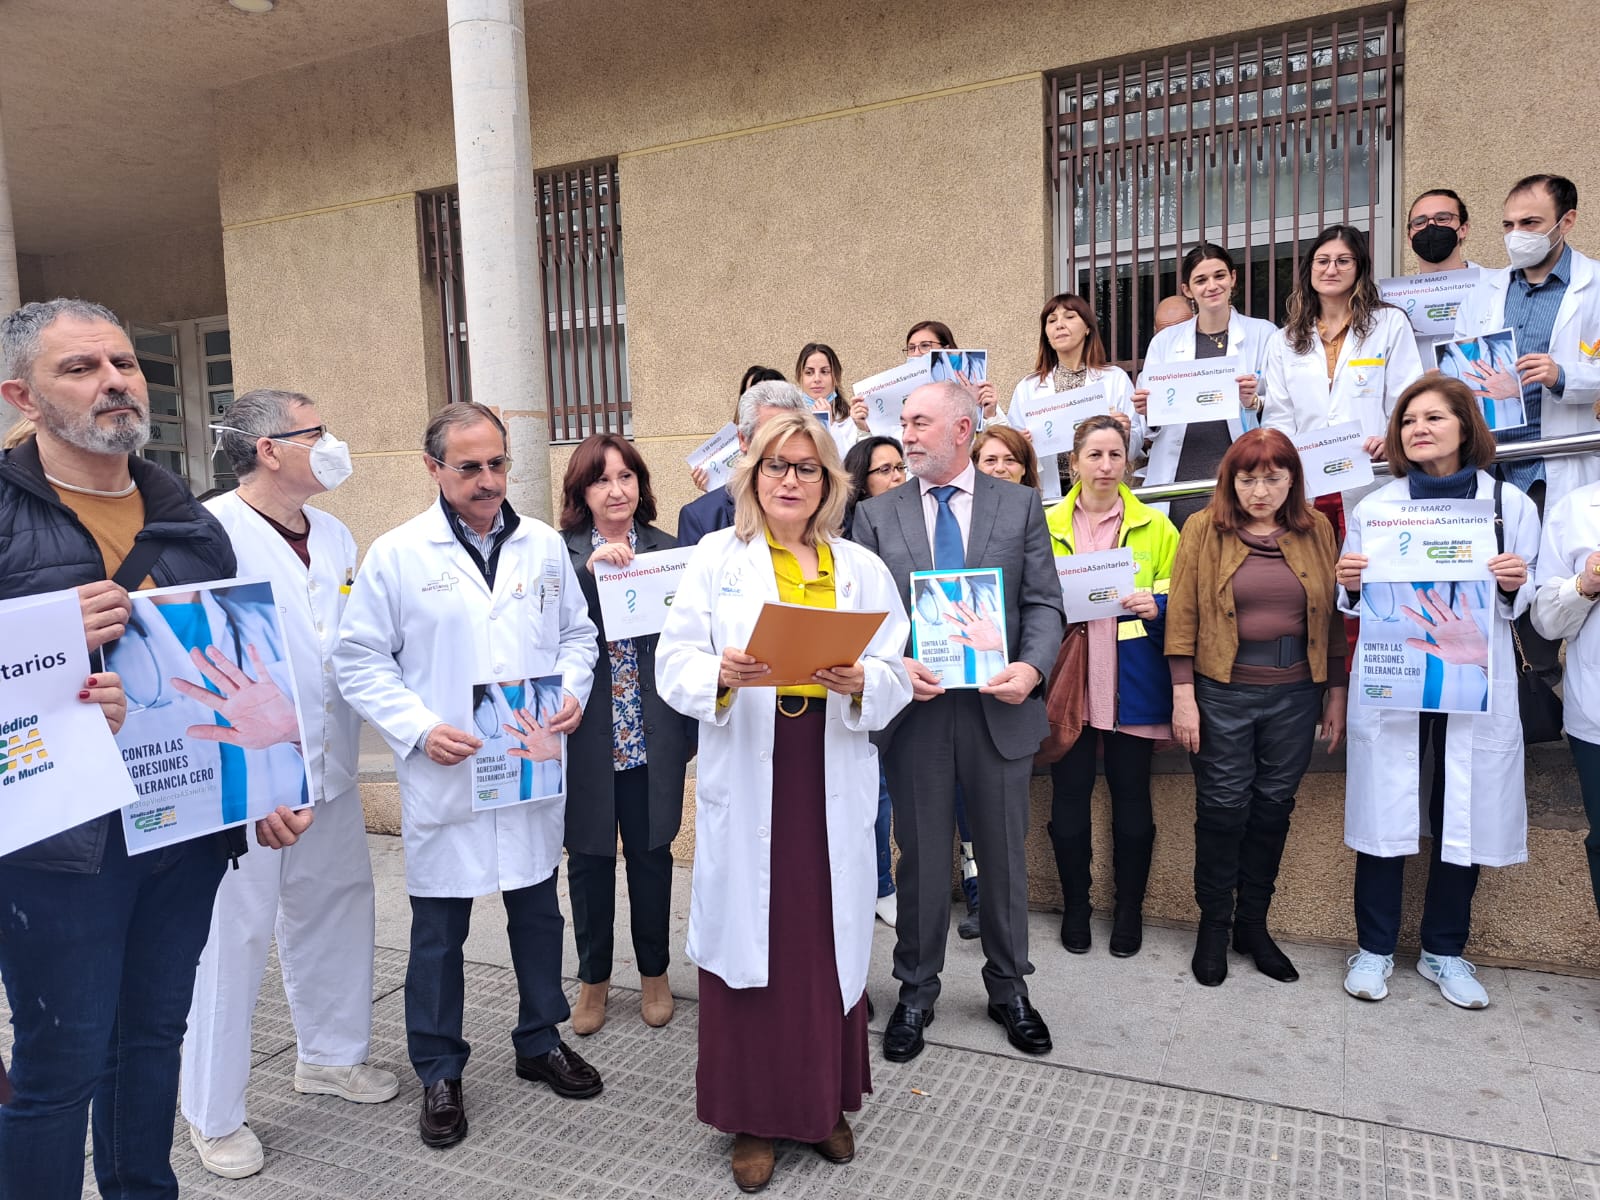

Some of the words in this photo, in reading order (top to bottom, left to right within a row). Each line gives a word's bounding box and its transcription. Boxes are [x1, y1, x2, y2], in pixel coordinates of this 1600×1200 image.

[1407, 505, 1419, 513] DE
[1420, 504, 1452, 512] MARZO
[1366, 515, 1488, 528] #StopViolenciaASanitarios
[599, 562, 688, 582] #StopViolenciaASanit
[1057, 560, 1130, 577] iolenciaASanitarios
[1363, 642, 1389, 652] CONTRA
[1390, 643, 1403, 652] LAS
[1363, 654, 1405, 664] AGRESIONES
[1363, 665, 1403, 676] TOLERANCIA
[1404, 667, 1421, 677] CERO
[0, 714, 39, 736] édico
[121, 742, 163, 762] CONTRA
[164, 738, 184, 754] LAS
[476, 757, 496, 765] CONTRA
[496, 754, 506, 763] LAS
[3, 773, 16, 787] de
[18, 760, 55, 781] Murcia
[134, 773, 188, 796] LERANCIA
[190, 767, 214, 784] CERO
